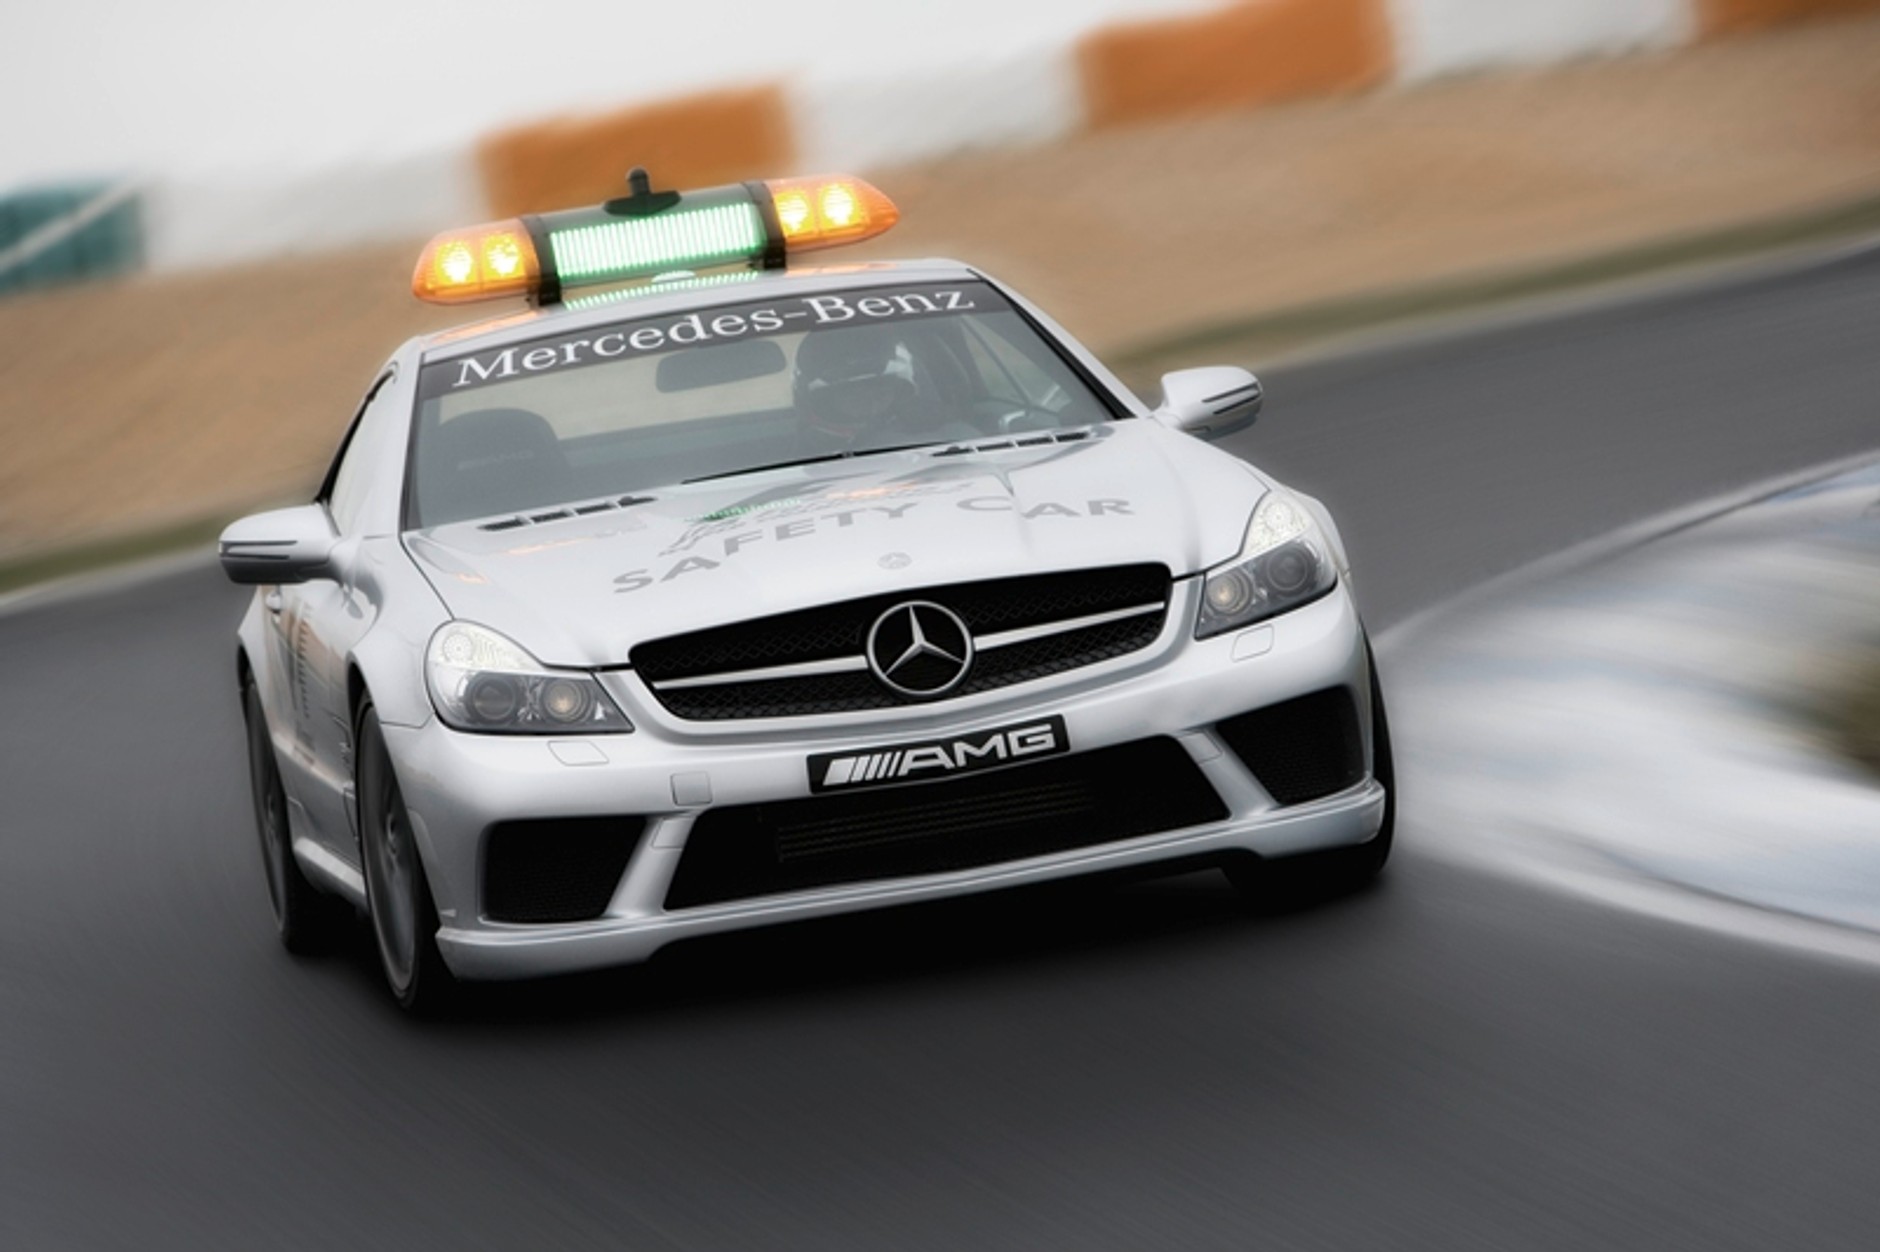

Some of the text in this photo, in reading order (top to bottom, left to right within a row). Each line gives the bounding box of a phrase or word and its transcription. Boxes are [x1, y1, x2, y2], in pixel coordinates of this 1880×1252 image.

[452, 290, 976, 387] Mercedes-Benz
[612, 497, 1136, 593] SAFETY CAR
[897, 724, 1056, 776] AMG
